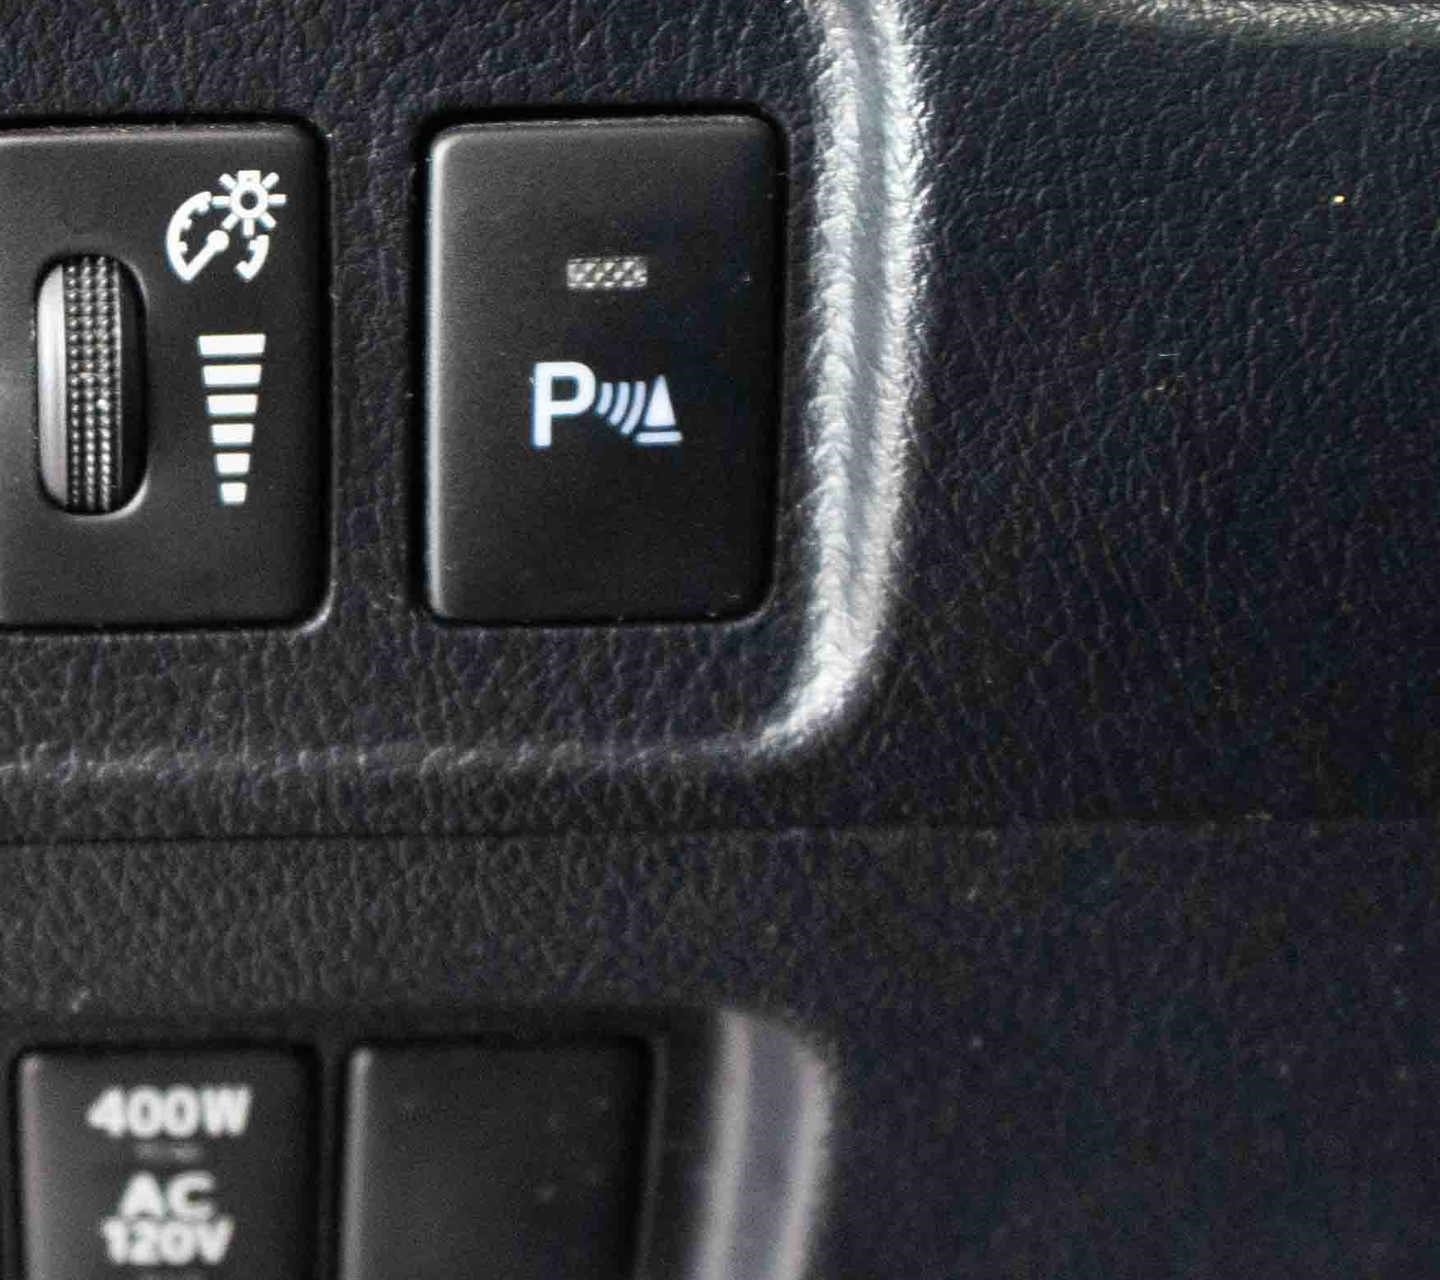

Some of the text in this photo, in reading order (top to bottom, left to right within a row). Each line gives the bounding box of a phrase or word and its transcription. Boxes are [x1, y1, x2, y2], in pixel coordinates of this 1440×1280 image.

[86, 1084, 252, 1140] 400W
[114, 1170, 217, 1220] AC
[100, 1216, 234, 1267] 120V
